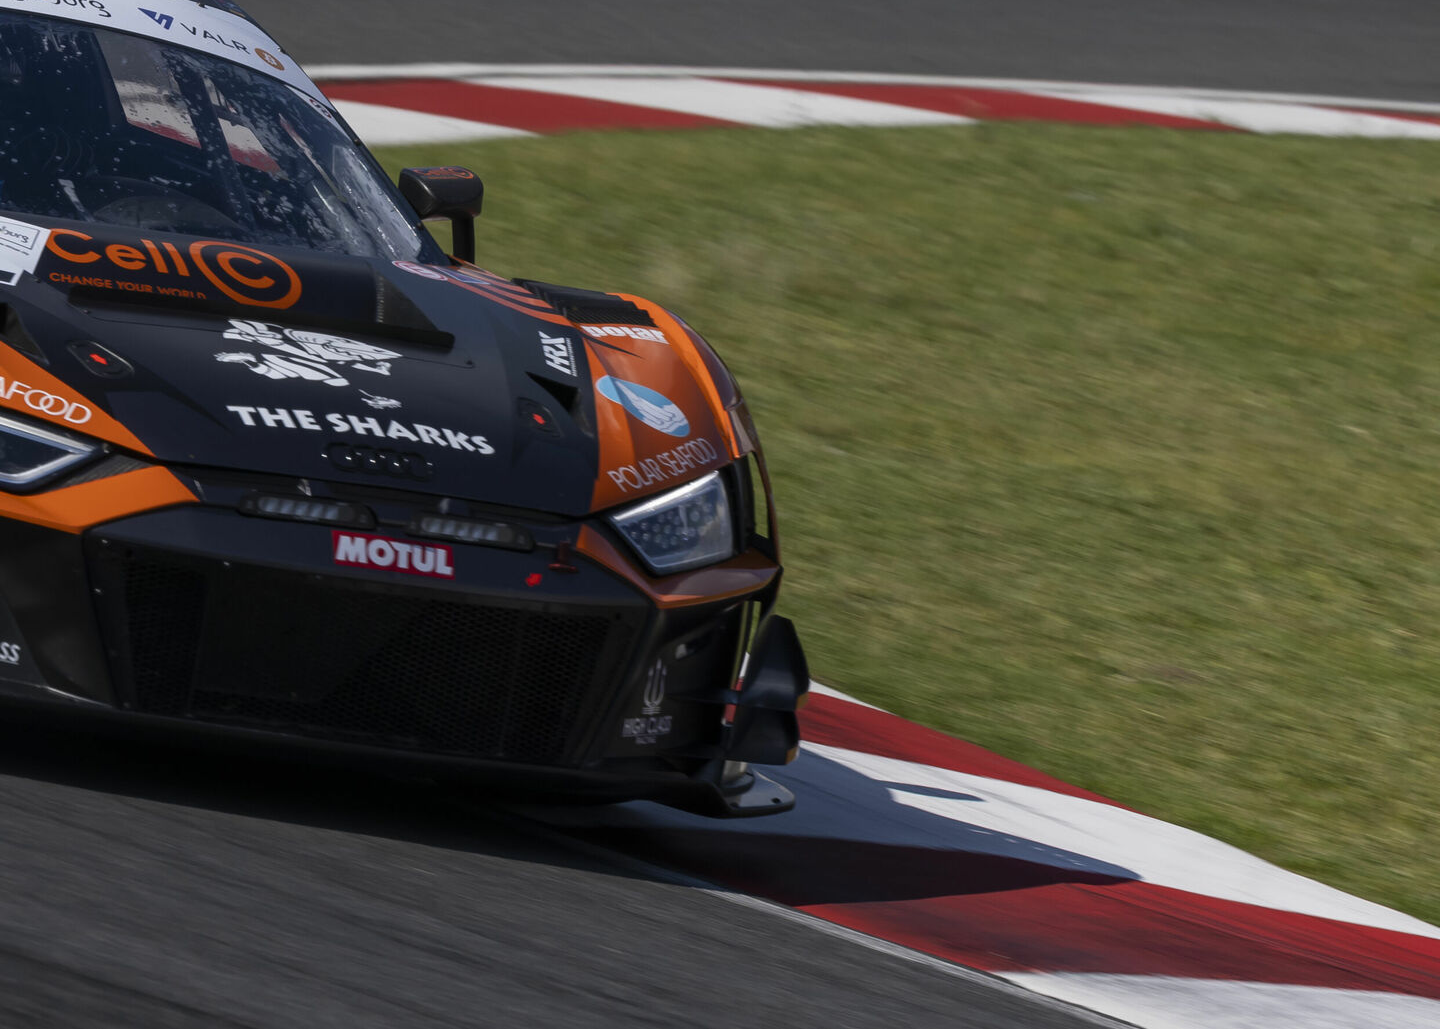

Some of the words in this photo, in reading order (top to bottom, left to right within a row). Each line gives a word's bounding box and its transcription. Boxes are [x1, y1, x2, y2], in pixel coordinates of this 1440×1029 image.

[179, 22, 251, 55] VALR
[45, 228, 191, 277] Cell
[48, 271, 114, 290] CHANGE
[115, 280, 154, 294] YOUR
[537, 330, 573, 375] HRX
[225, 405, 323, 432] THE
[326, 412, 497, 456] SHARKS
[607, 458, 670, 493] POLAR
[656, 437, 718, 477] SEAFOOD
[335, 534, 454, 576] MOTUL
